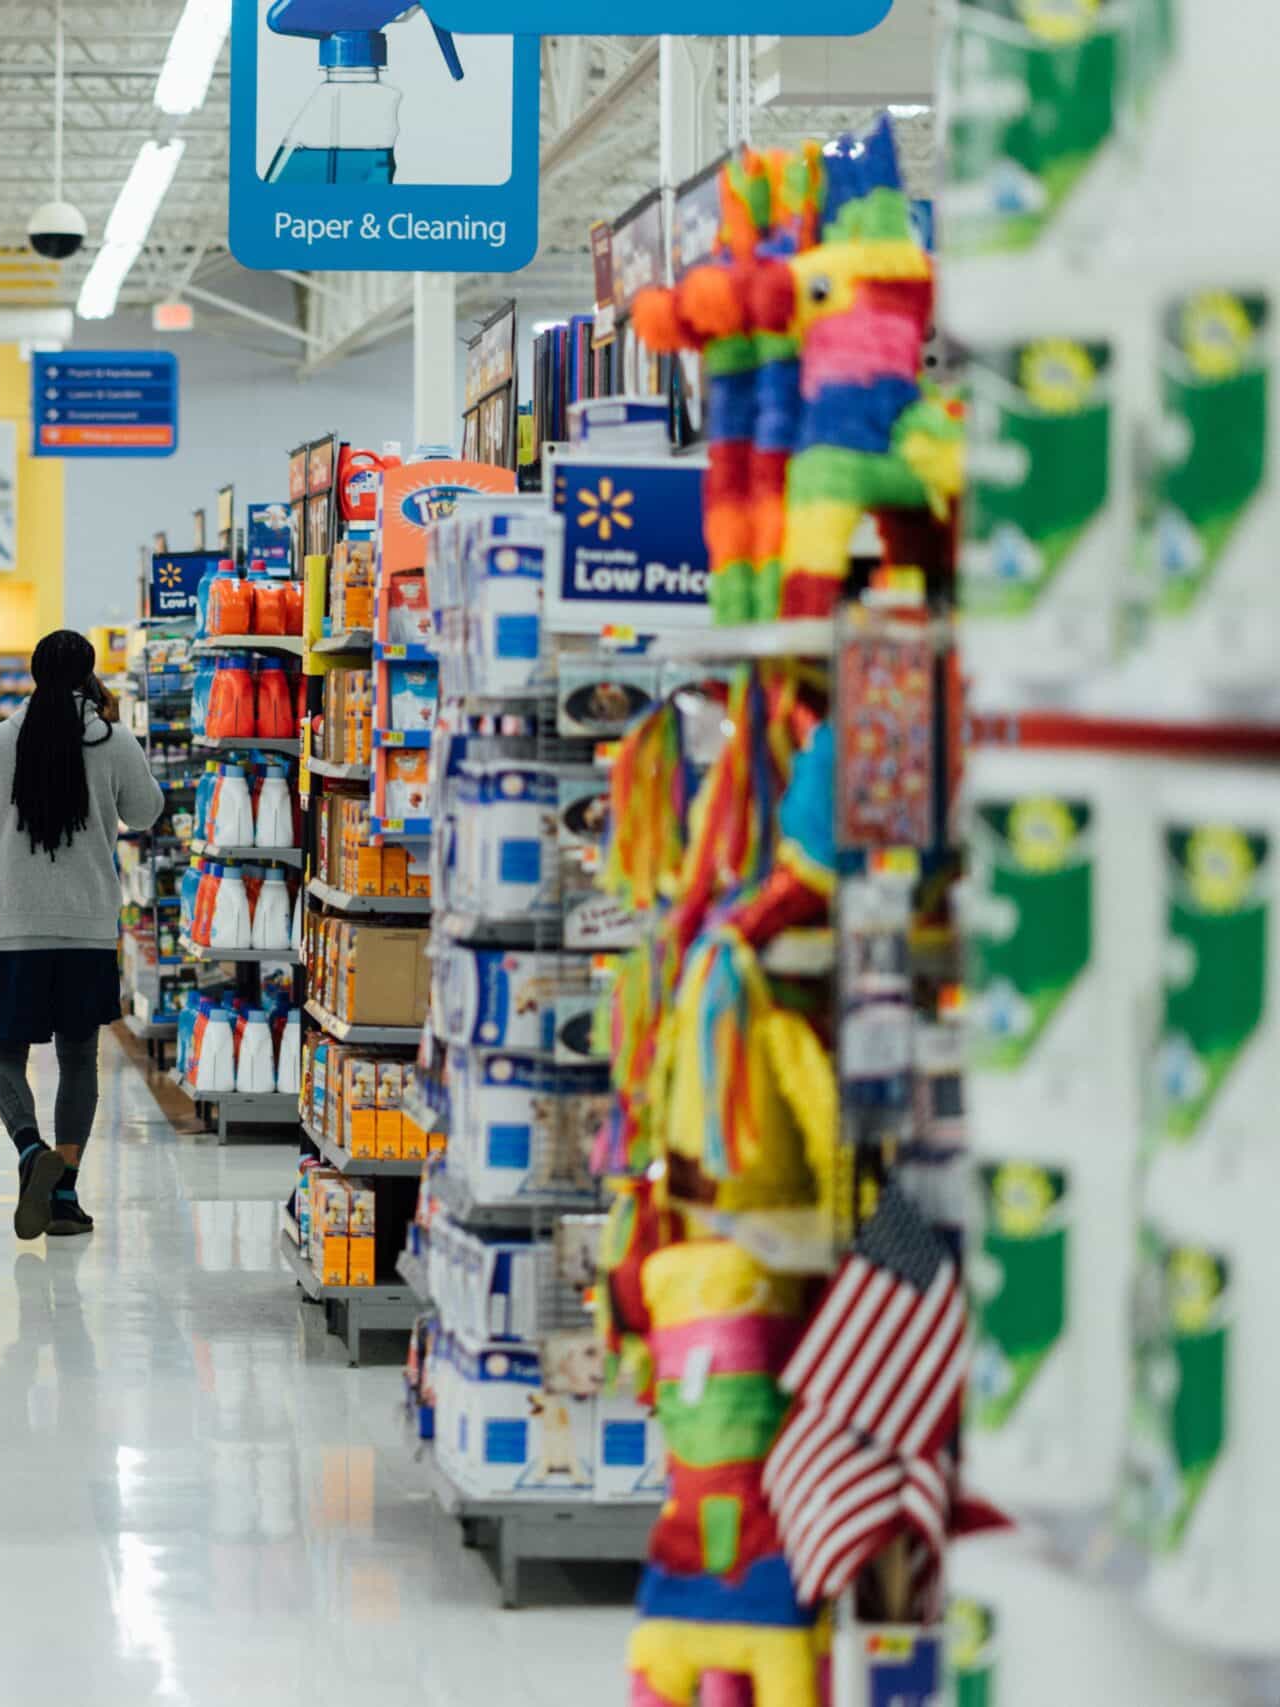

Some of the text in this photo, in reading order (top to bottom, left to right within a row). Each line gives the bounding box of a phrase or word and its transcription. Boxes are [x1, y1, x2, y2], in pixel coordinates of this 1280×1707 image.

[274, 211, 506, 248] Paper & Cleaning
[574, 562, 641, 592] Low
[644, 563, 712, 594] Pric
